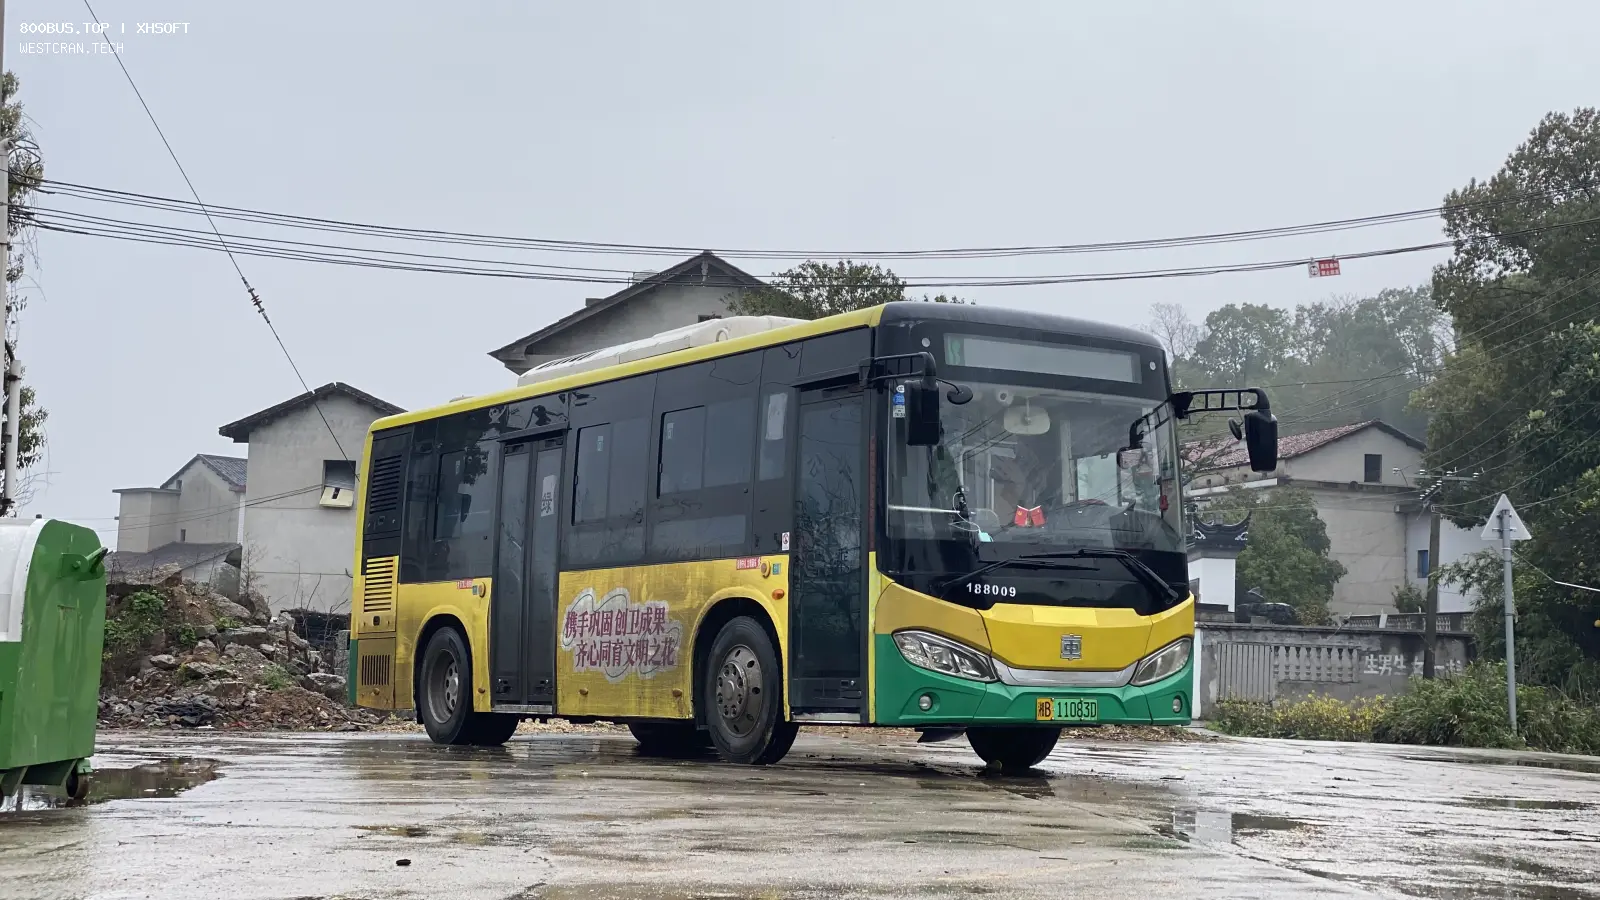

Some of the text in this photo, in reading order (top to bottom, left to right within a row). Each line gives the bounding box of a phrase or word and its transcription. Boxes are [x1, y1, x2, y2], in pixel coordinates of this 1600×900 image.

[966, 582, 1017, 598] 188009
[565, 607, 667, 639] 携手巩固创卫成果
[575, 637, 676, 668] 齐心同育文明之花
